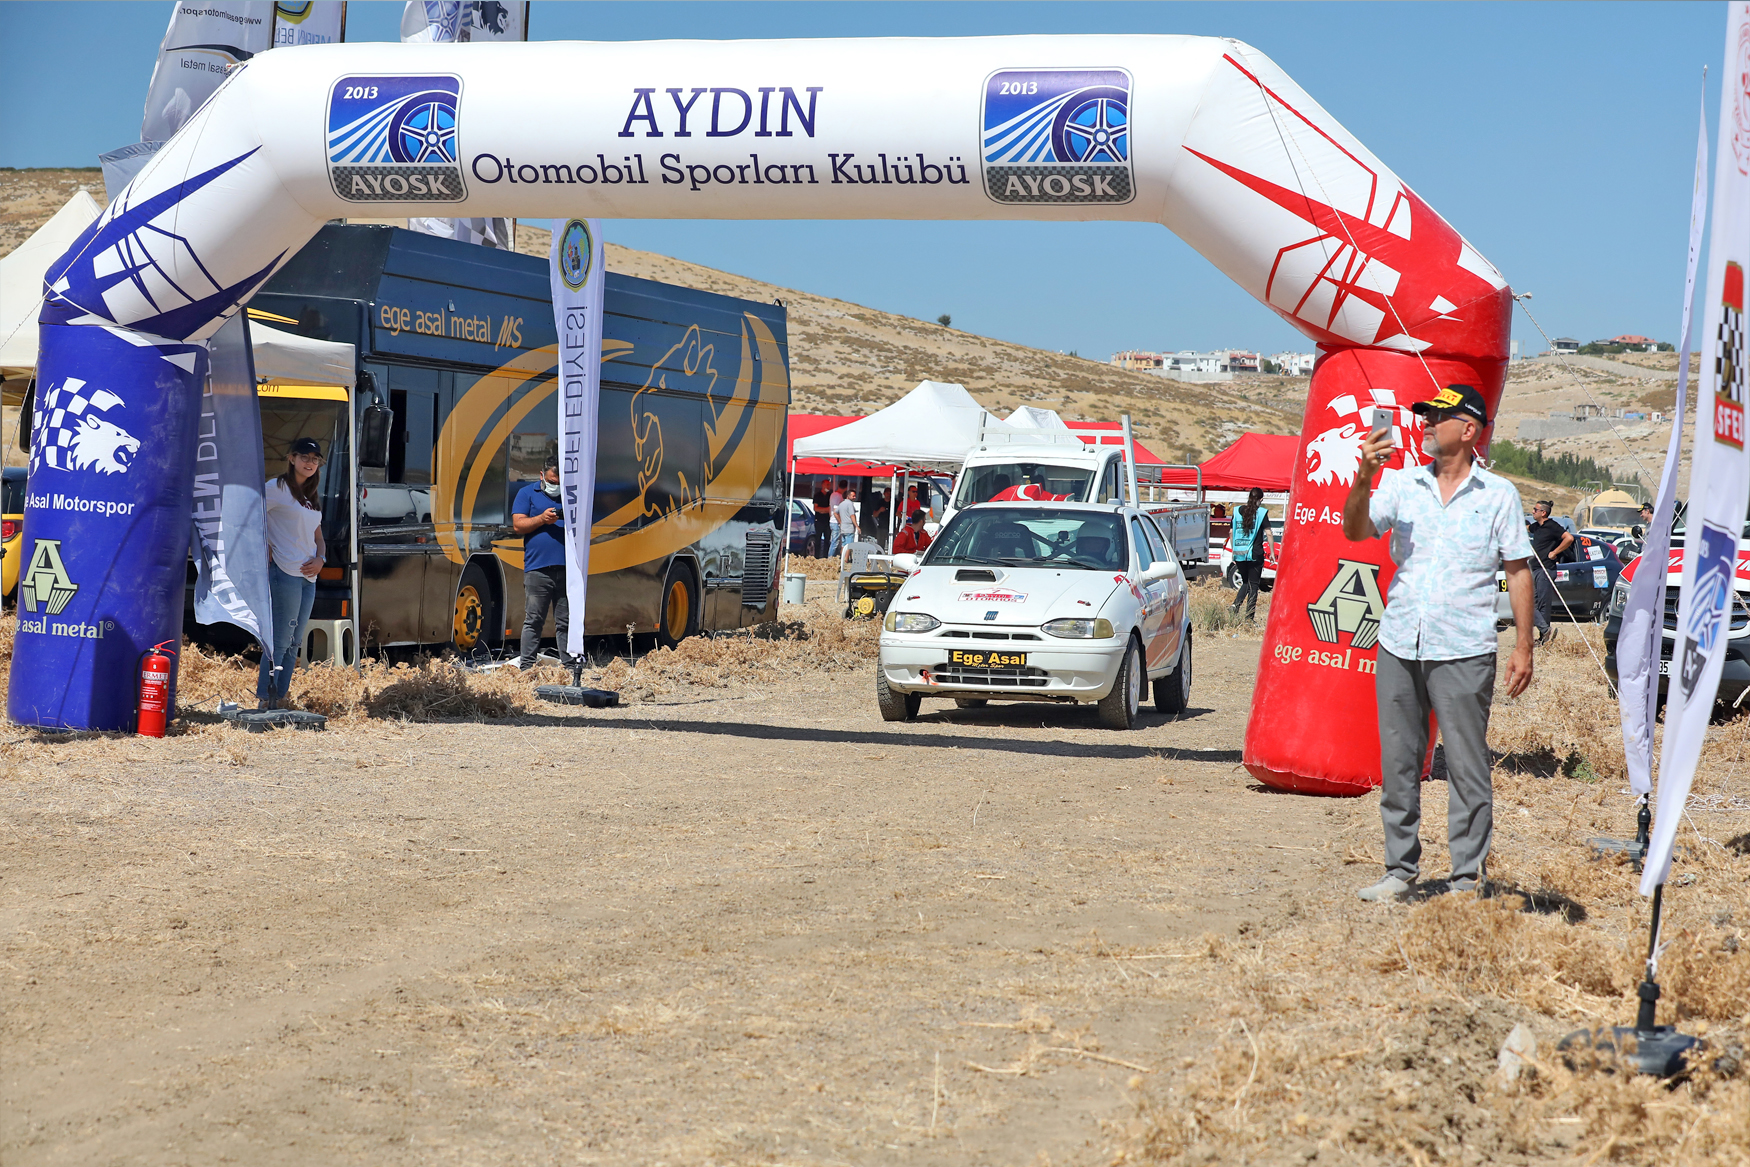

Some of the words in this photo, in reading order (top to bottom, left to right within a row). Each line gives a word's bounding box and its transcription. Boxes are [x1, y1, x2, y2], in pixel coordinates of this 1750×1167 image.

[343, 86, 379, 100] 2013
[999, 81, 1038, 96] 2013
[617, 87, 823, 139] AYDIN
[471, 153, 649, 185] Otomobil
[661, 153, 819, 191] Sporları
[827, 153, 970, 185] Kulübü
[350, 173, 454, 196] AYOSK
[1003, 174, 1118, 197] AYOSK
[381, 305, 411, 336] ege
[415, 308, 446, 336] asal
[451, 315, 491, 342] metal
[29, 493, 49, 509] Asal
[52, 493, 135, 517] Motorspor
[1294, 502, 1316, 525] Ege
[1580, 536, 1592, 546] 20
[22, 616, 47, 634] asal
[952, 651, 984, 666] Ege
[988, 652, 1026, 665] Asal
[1274, 643, 1302, 664] ege
[1307, 649, 1351, 670] asal
